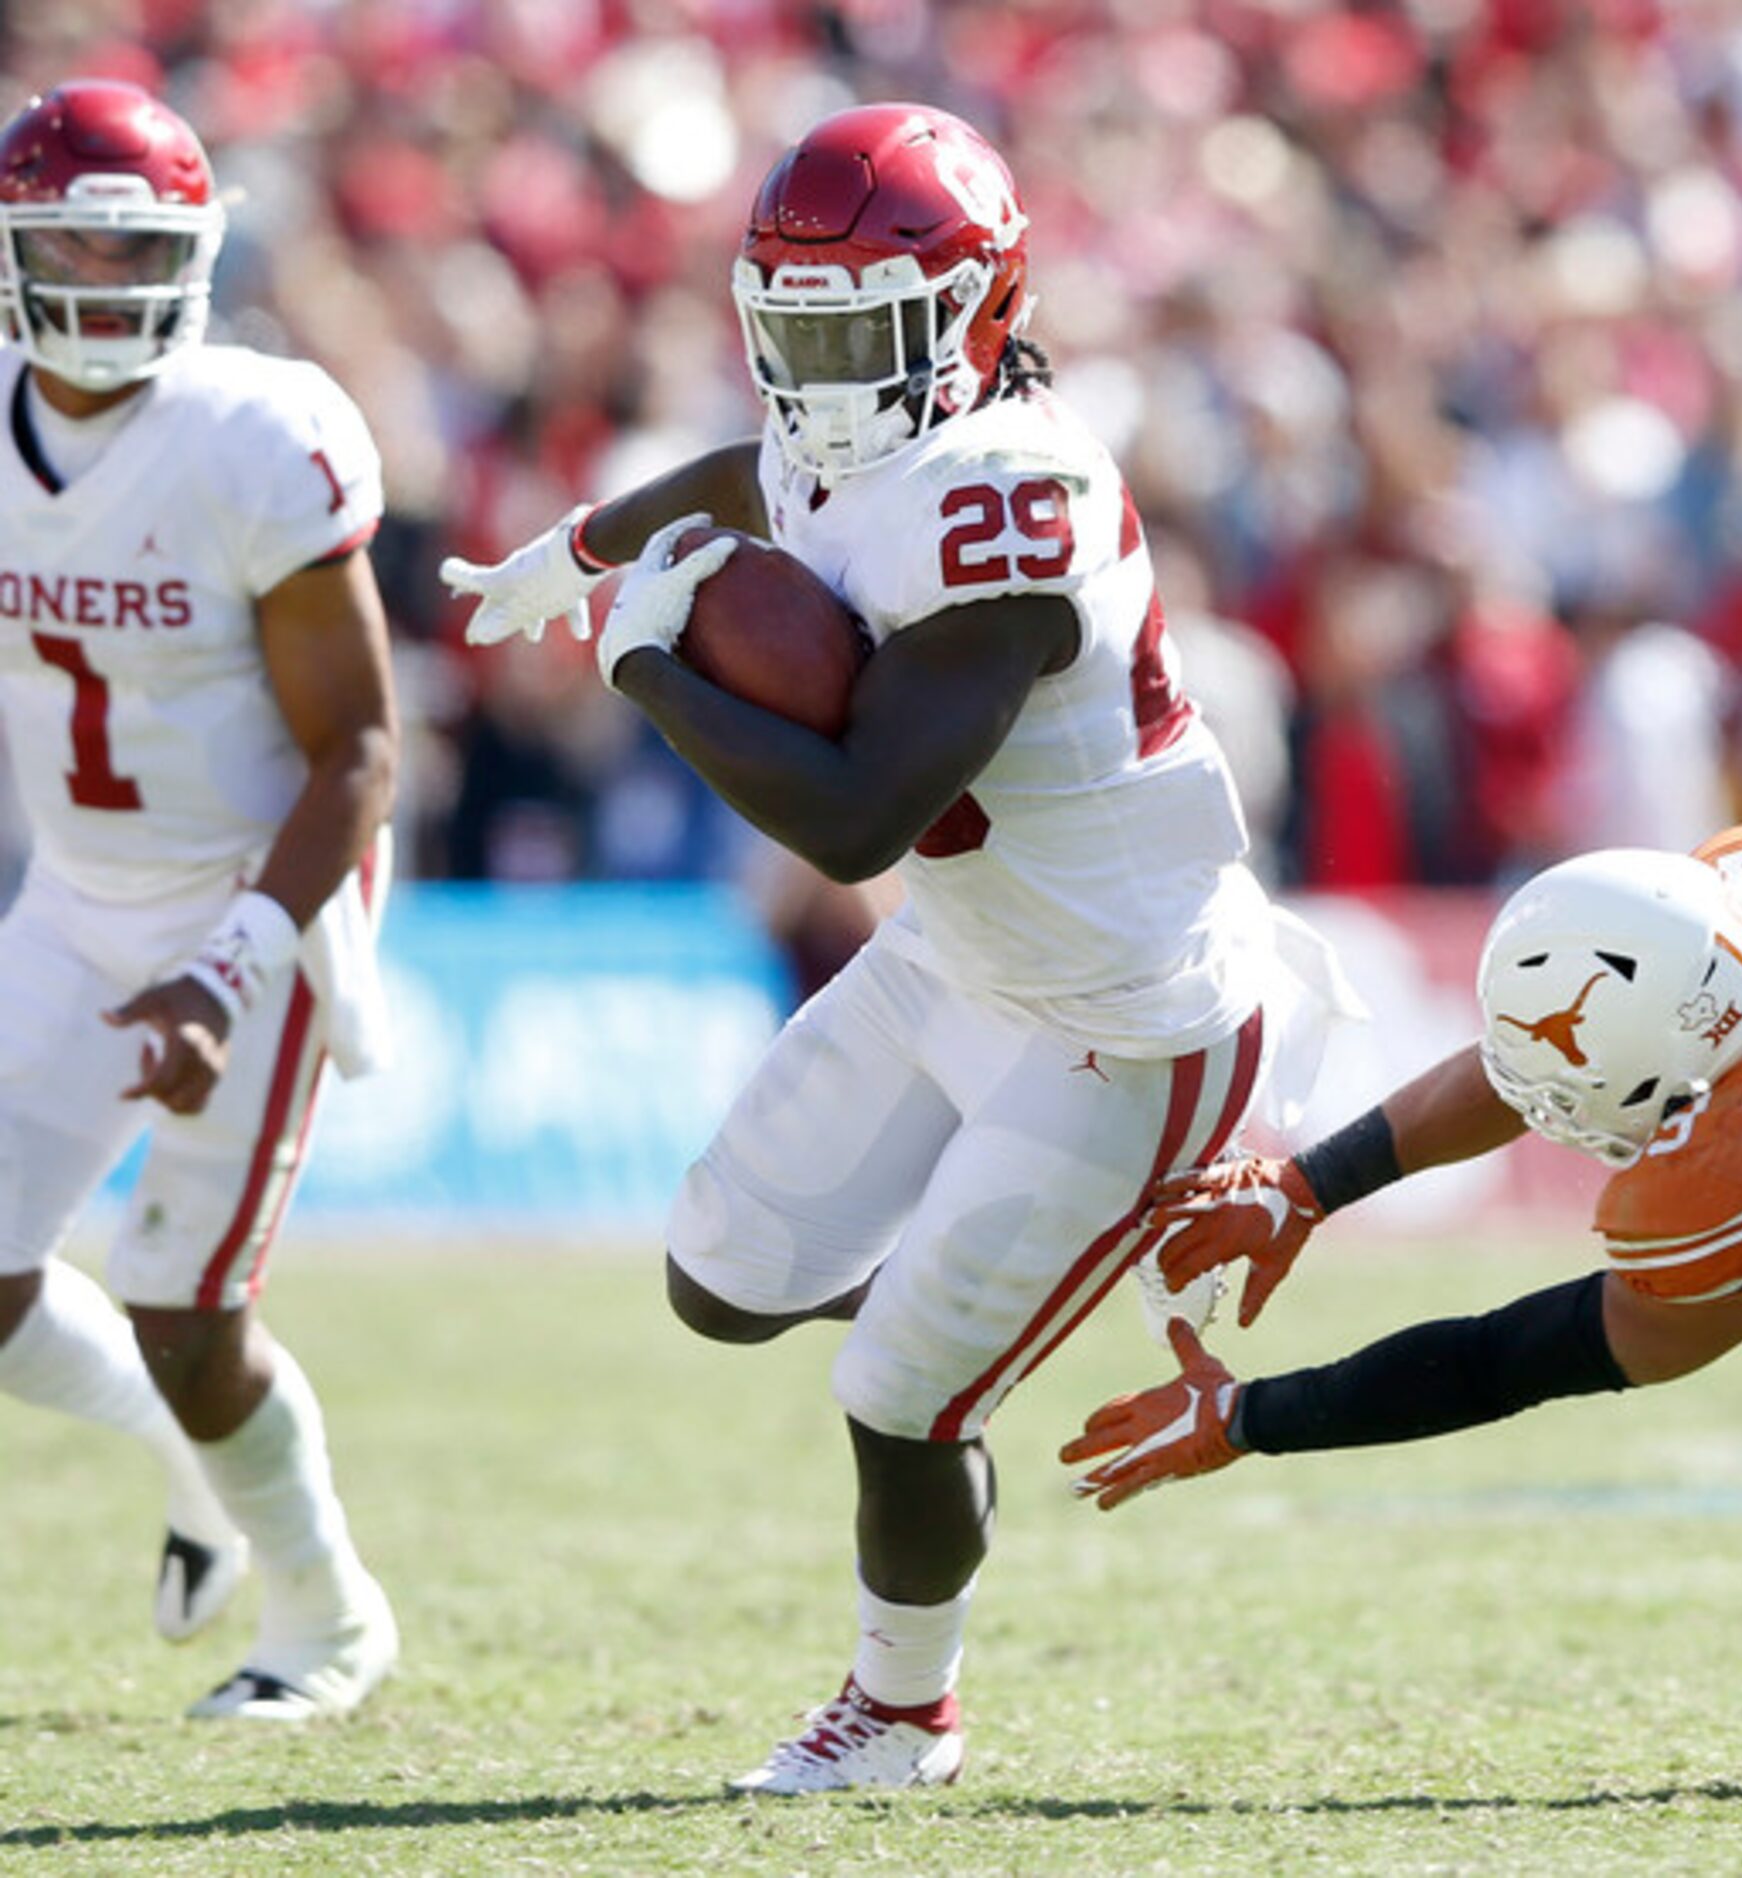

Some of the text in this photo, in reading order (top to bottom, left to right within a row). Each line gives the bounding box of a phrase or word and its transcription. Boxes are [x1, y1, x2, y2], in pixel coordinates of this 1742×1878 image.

[310, 449, 346, 515] 1
[939, 478, 1075, 588] 29
[31, 631, 145, 812] 1
